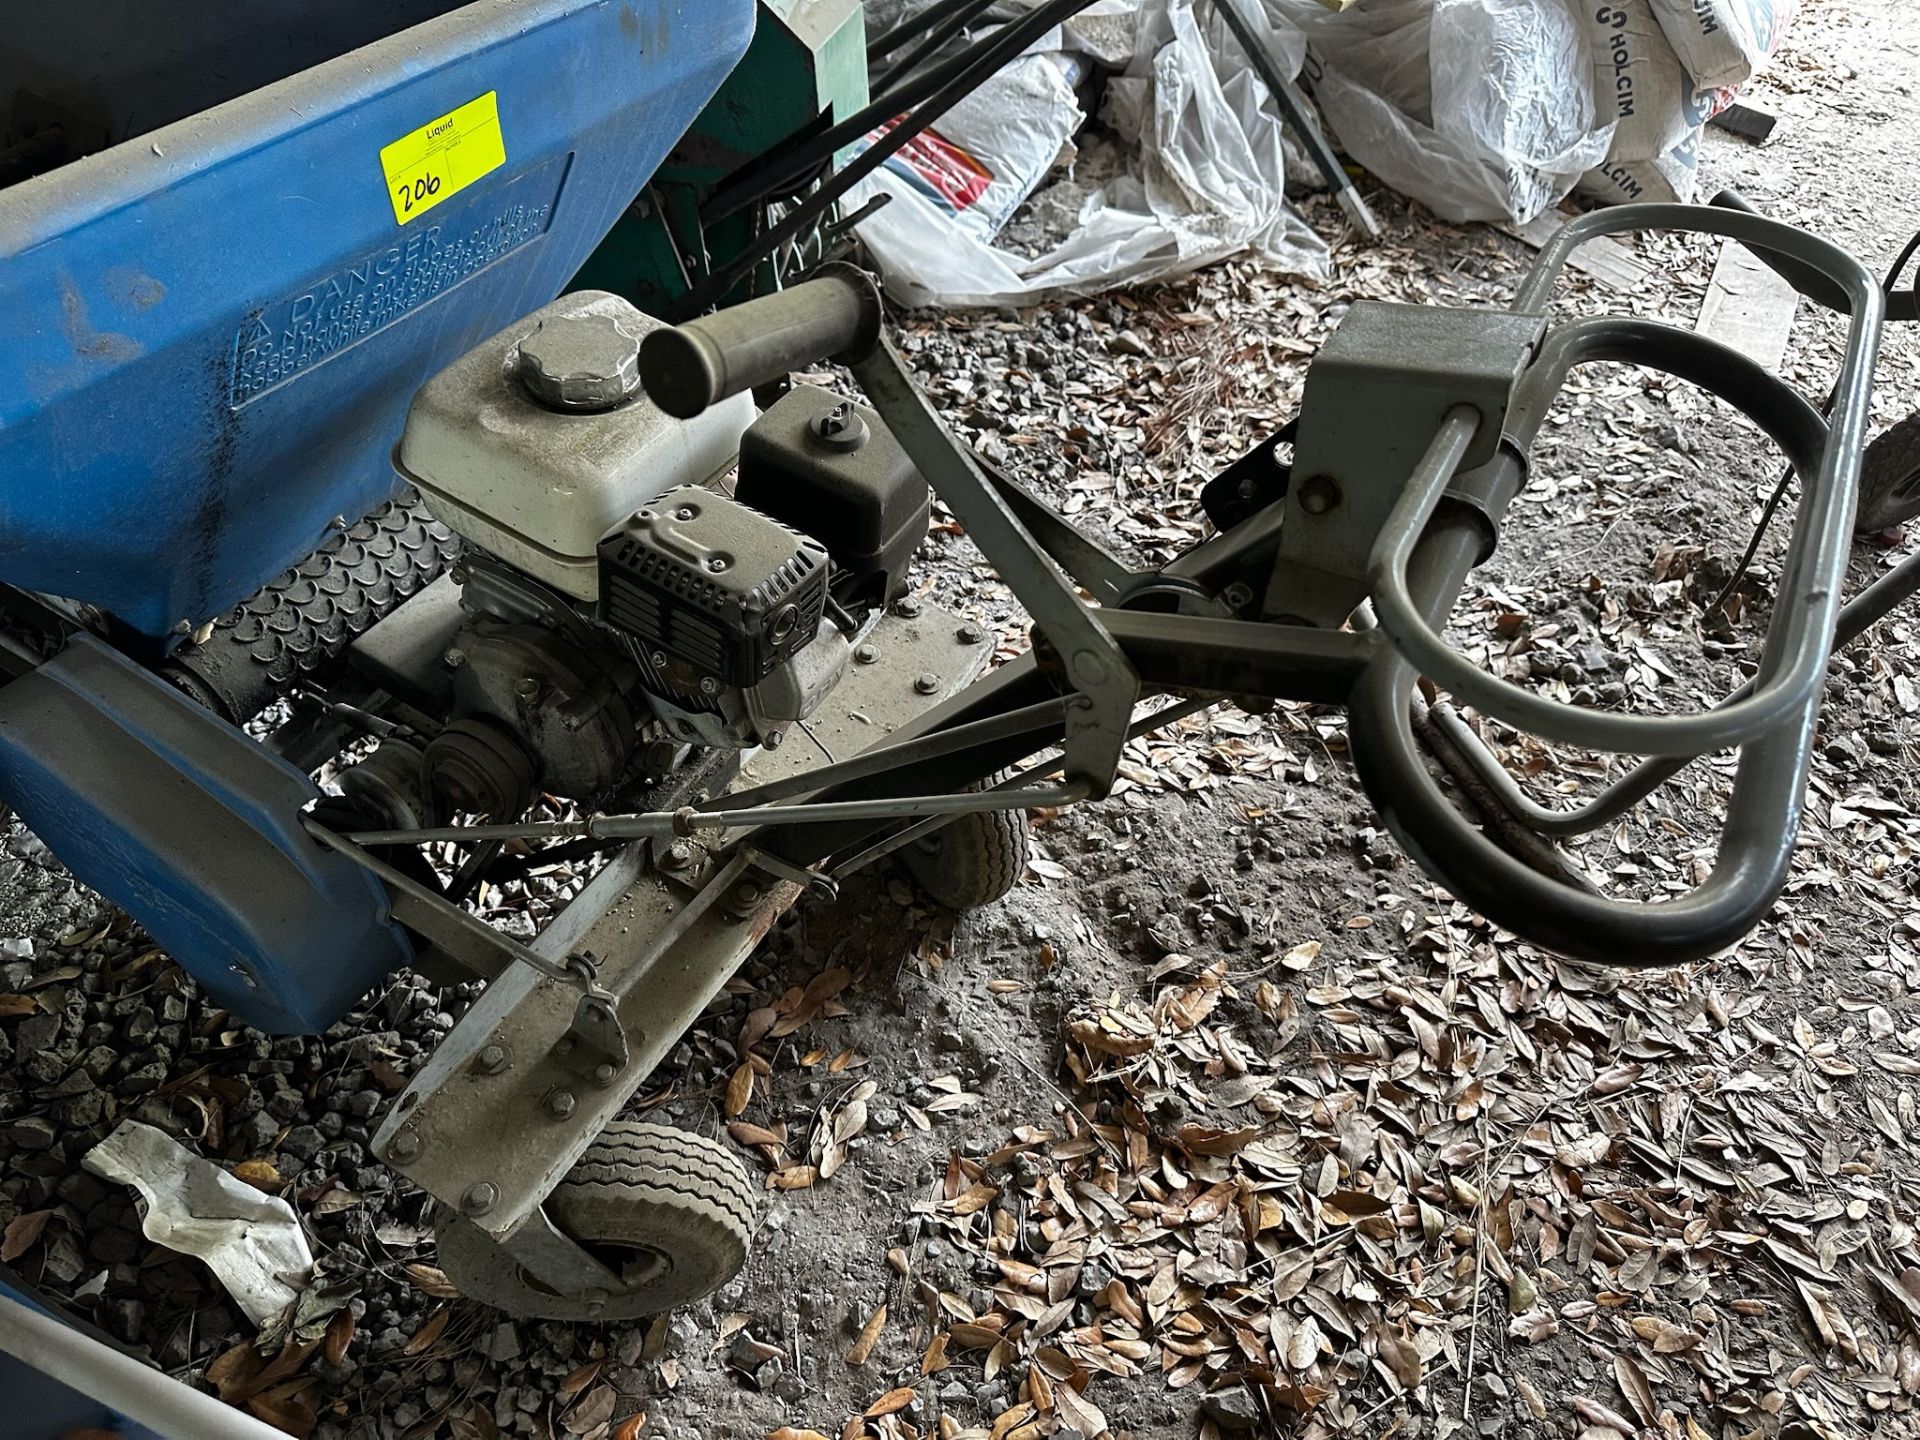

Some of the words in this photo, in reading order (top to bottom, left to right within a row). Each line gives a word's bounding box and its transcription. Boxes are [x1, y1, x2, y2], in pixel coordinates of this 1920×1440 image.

[1609, 33, 1634, 117] HOLCIM
[426, 117, 453, 139] Liquid
[398, 172, 440, 212] 206
[1596, 161, 1643, 198] LCIM
[241, 345, 295, 381] Keep
[302, 309, 363, 350] hands
[369, 283, 405, 314] and
[409, 247, 471, 291] objects
[476, 231, 499, 254] out
[523, 203, 548, 227] the
[243, 342, 273, 366] Do
[283, 312, 321, 347] Not
[330, 294, 364, 320] use
[372, 276, 396, 298] on
[404, 239, 463, 283] slopes
[469, 225, 487, 244] or
[291, 226, 440, 322] DANGER
[239, 348, 315, 396] hopper
[321, 320, 370, 354] while
[376, 289, 424, 326] mixer
[427, 279, 440, 296] is
[443, 266, 458, 287] in
